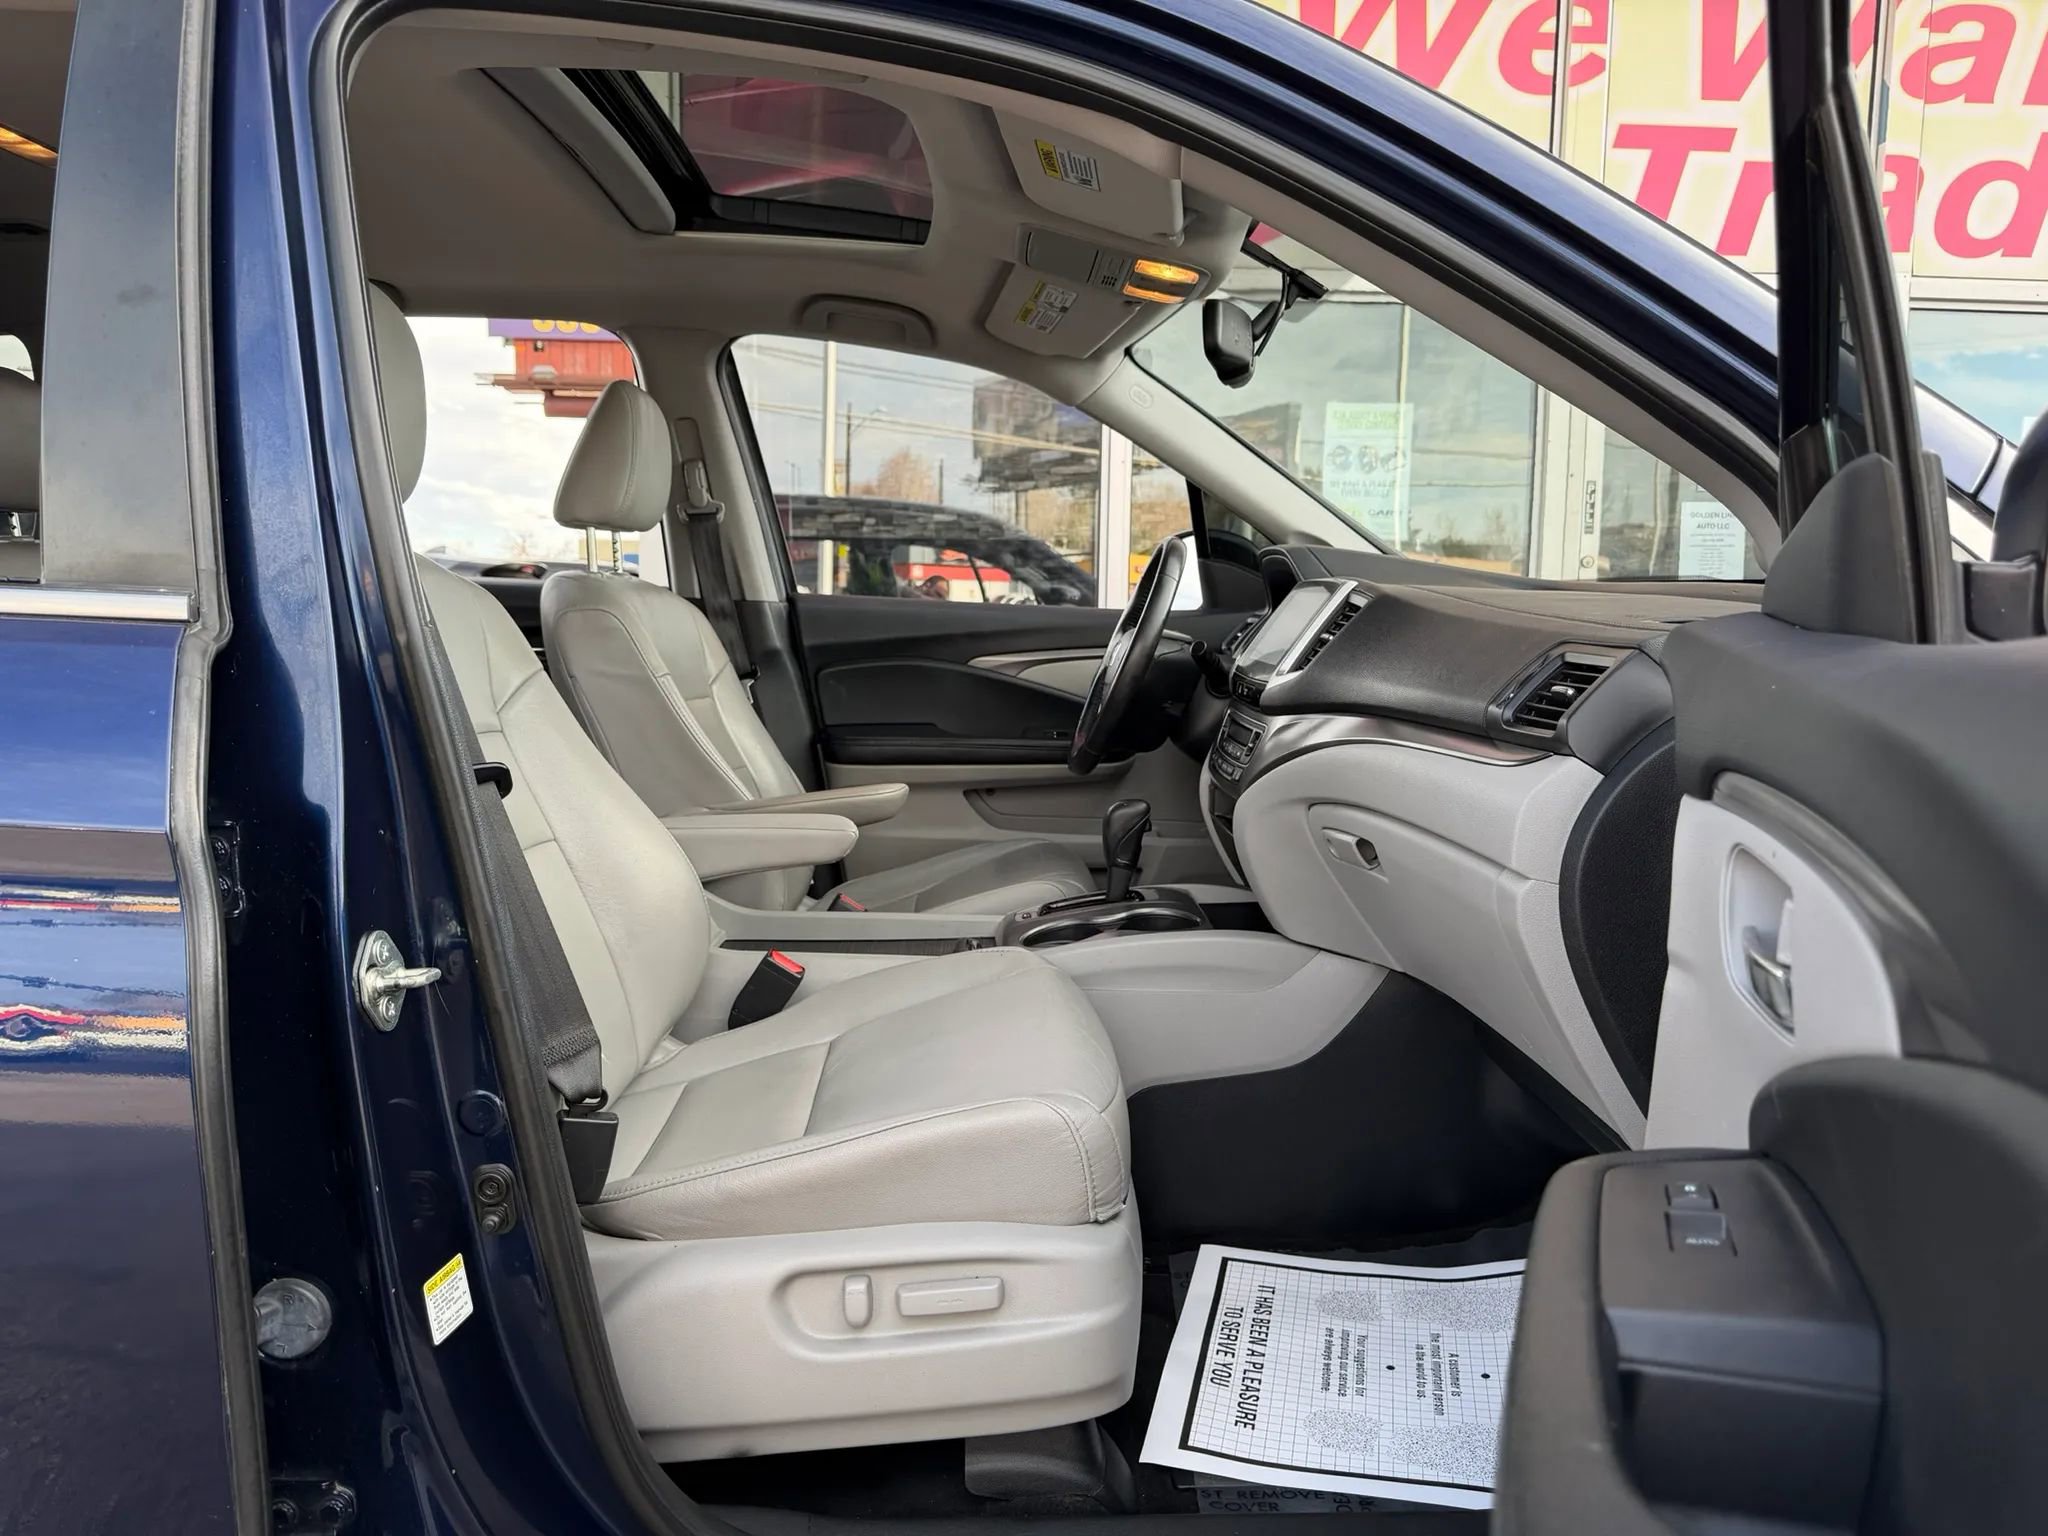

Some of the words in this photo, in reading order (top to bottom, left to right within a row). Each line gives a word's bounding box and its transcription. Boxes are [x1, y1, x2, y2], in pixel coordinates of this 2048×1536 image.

[1295, 0, 1608, 96] We
[1701, 0, 2048, 105] Wa
[1696, 522, 1716, 530] AUTO
[1257, 1285, 1276, 1295] IT
[1223, 1306, 1244, 1319] TO
[1253, 1296, 1274, 1316] HAS
[1216, 1320, 1241, 1359] SERVE
[1248, 1317, 1271, 1347] BEEN
[1325, 1327, 1335, 1338] are
[1430, 1332, 1441, 1342] the
[1321, 1338, 1336, 1361] always
[1338, 1328, 1352, 1360] improving
[1356, 1335, 1368, 1348] Your
[1246, 1348, 1266, 1357] A
[1415, 1351, 1426, 1361] the
[1431, 1344, 1442, 1360] most
[1209, 1361, 1234, 1388] YOU
[1339, 1361, 1349, 1372] our
[1354, 1349, 1367, 1386] suggestions
[1415, 1362, 1428, 1380] world
[1448, 1359, 1460, 1389] customer
[1337, 1372, 1350, 1397] service
[1431, 1360, 1445, 1392] important
[1354, 1386, 1367, 1397] for
[1416, 1381, 1427, 1389] to
[1234, 1360, 1264, 1431] PLEASURE
[1432, 1392, 1445, 1416] person
[1236, 1489, 1327, 1500] REMOVE
[1208, 1501, 1281, 1513] COVER
